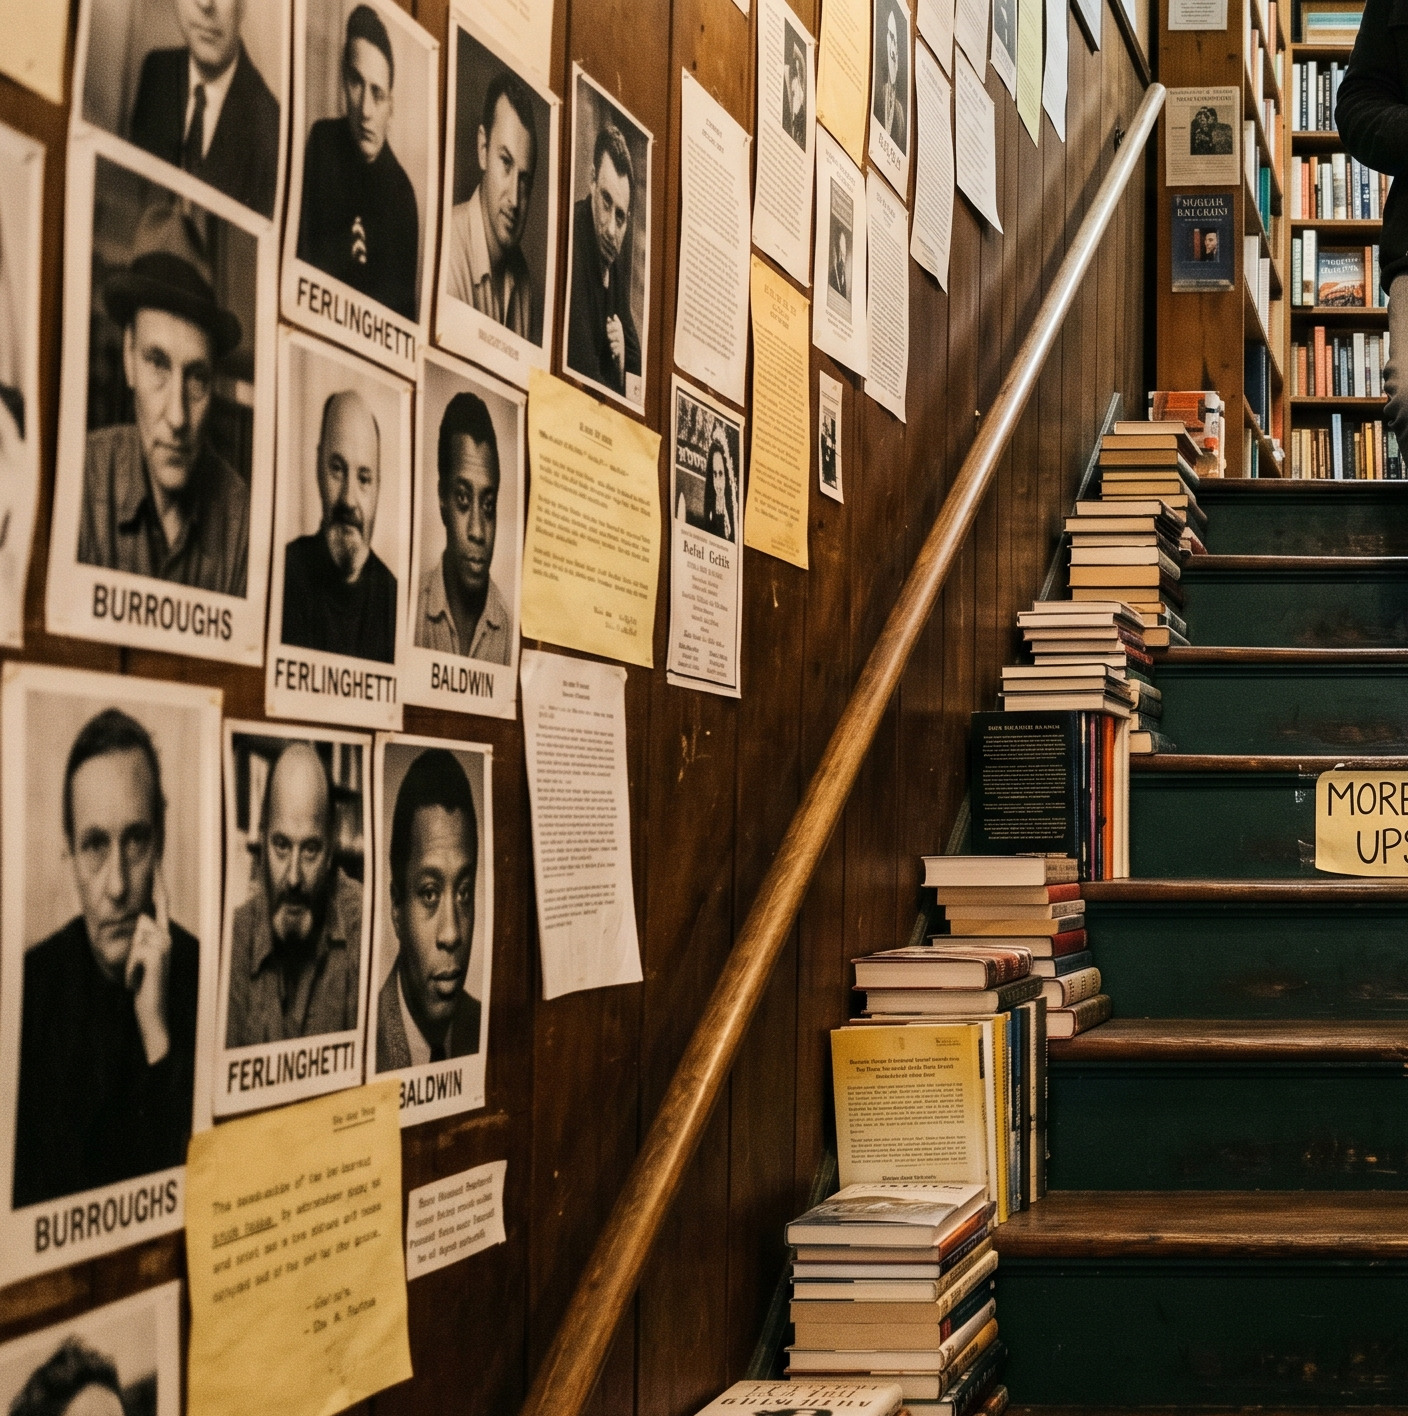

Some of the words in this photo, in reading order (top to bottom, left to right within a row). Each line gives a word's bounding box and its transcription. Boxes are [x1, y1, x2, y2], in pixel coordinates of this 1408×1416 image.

[297, 276, 416, 363] FERLINGHETTI
[93, 583, 233, 641] BURROUGHS
[274, 657, 398, 704] FERLINGHETTI
[431, 662, 495, 699] BALDWIN
[226, 1041, 356, 1094] FERLINGHETTI
[399, 1068, 462, 1110] BALDWIN
[34, 1178, 178, 1255] BURROUGHS
